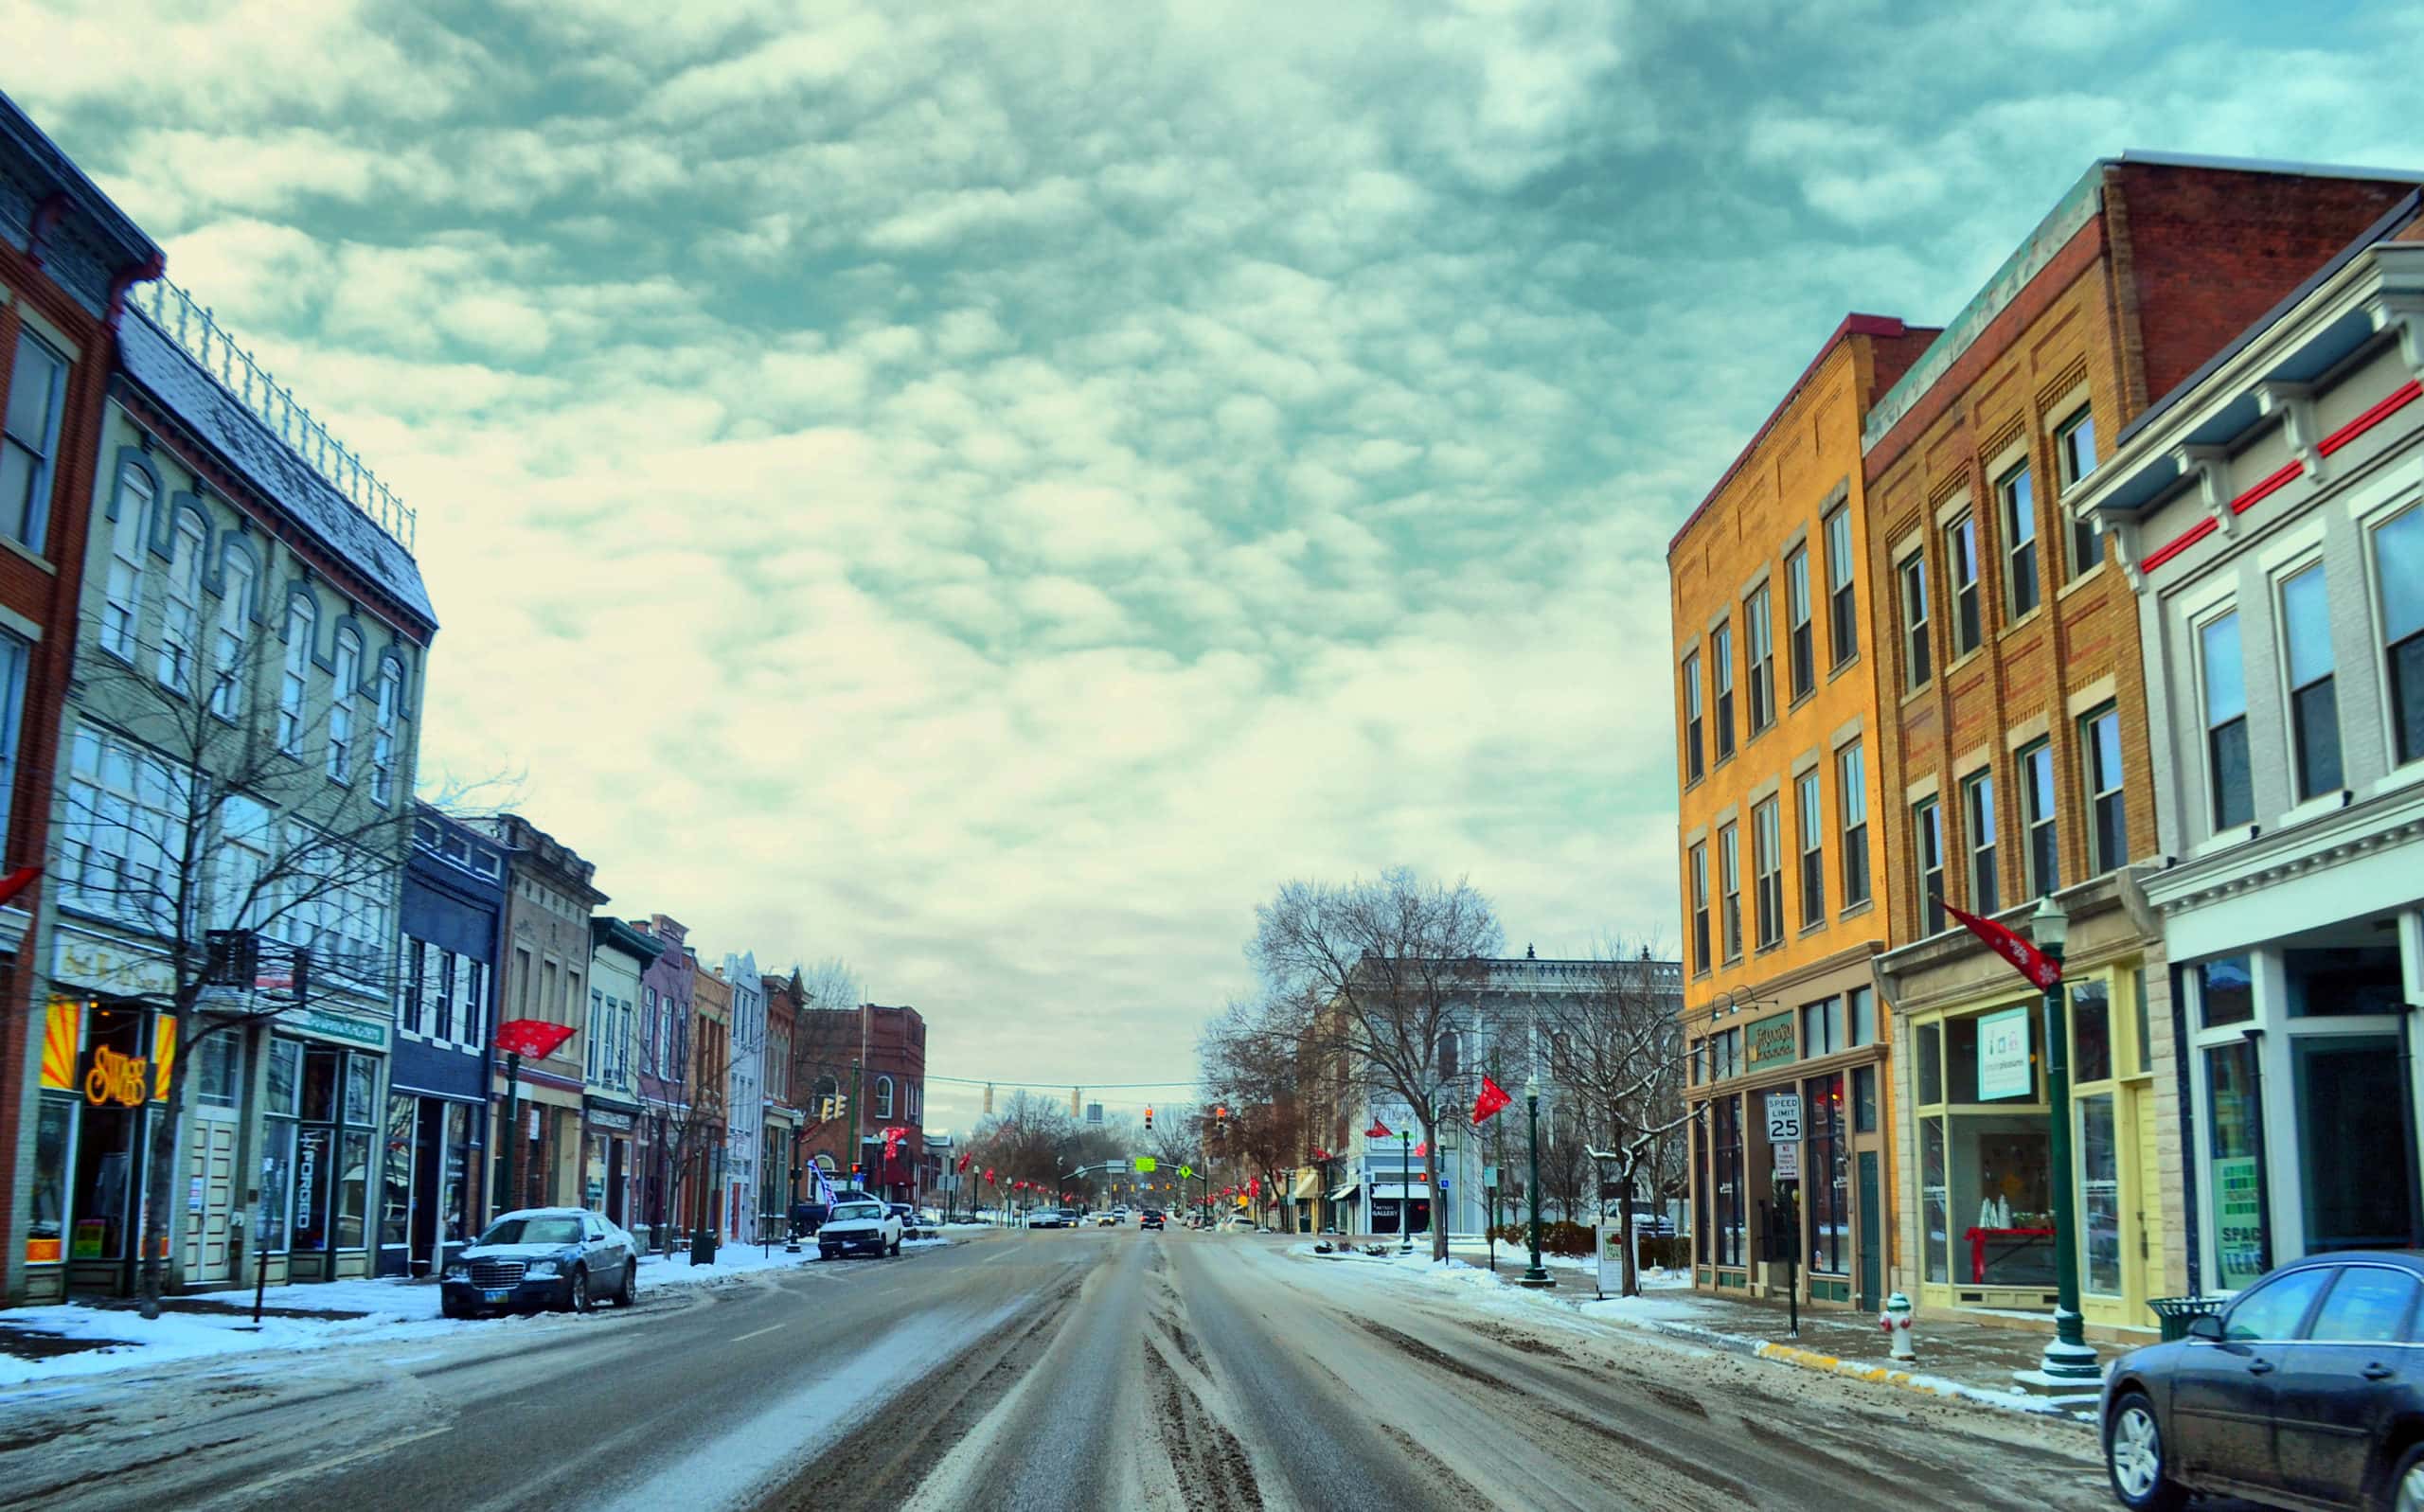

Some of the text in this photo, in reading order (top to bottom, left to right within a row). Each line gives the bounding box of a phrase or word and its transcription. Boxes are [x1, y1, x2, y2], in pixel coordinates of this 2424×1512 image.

[1772, 1109, 1795, 1117] LIMIT
[1771, 1120, 1799, 1136] 25
[2222, 1227, 2264, 1241] SPAC
[2225, 1253, 2265, 1274] LEAS
